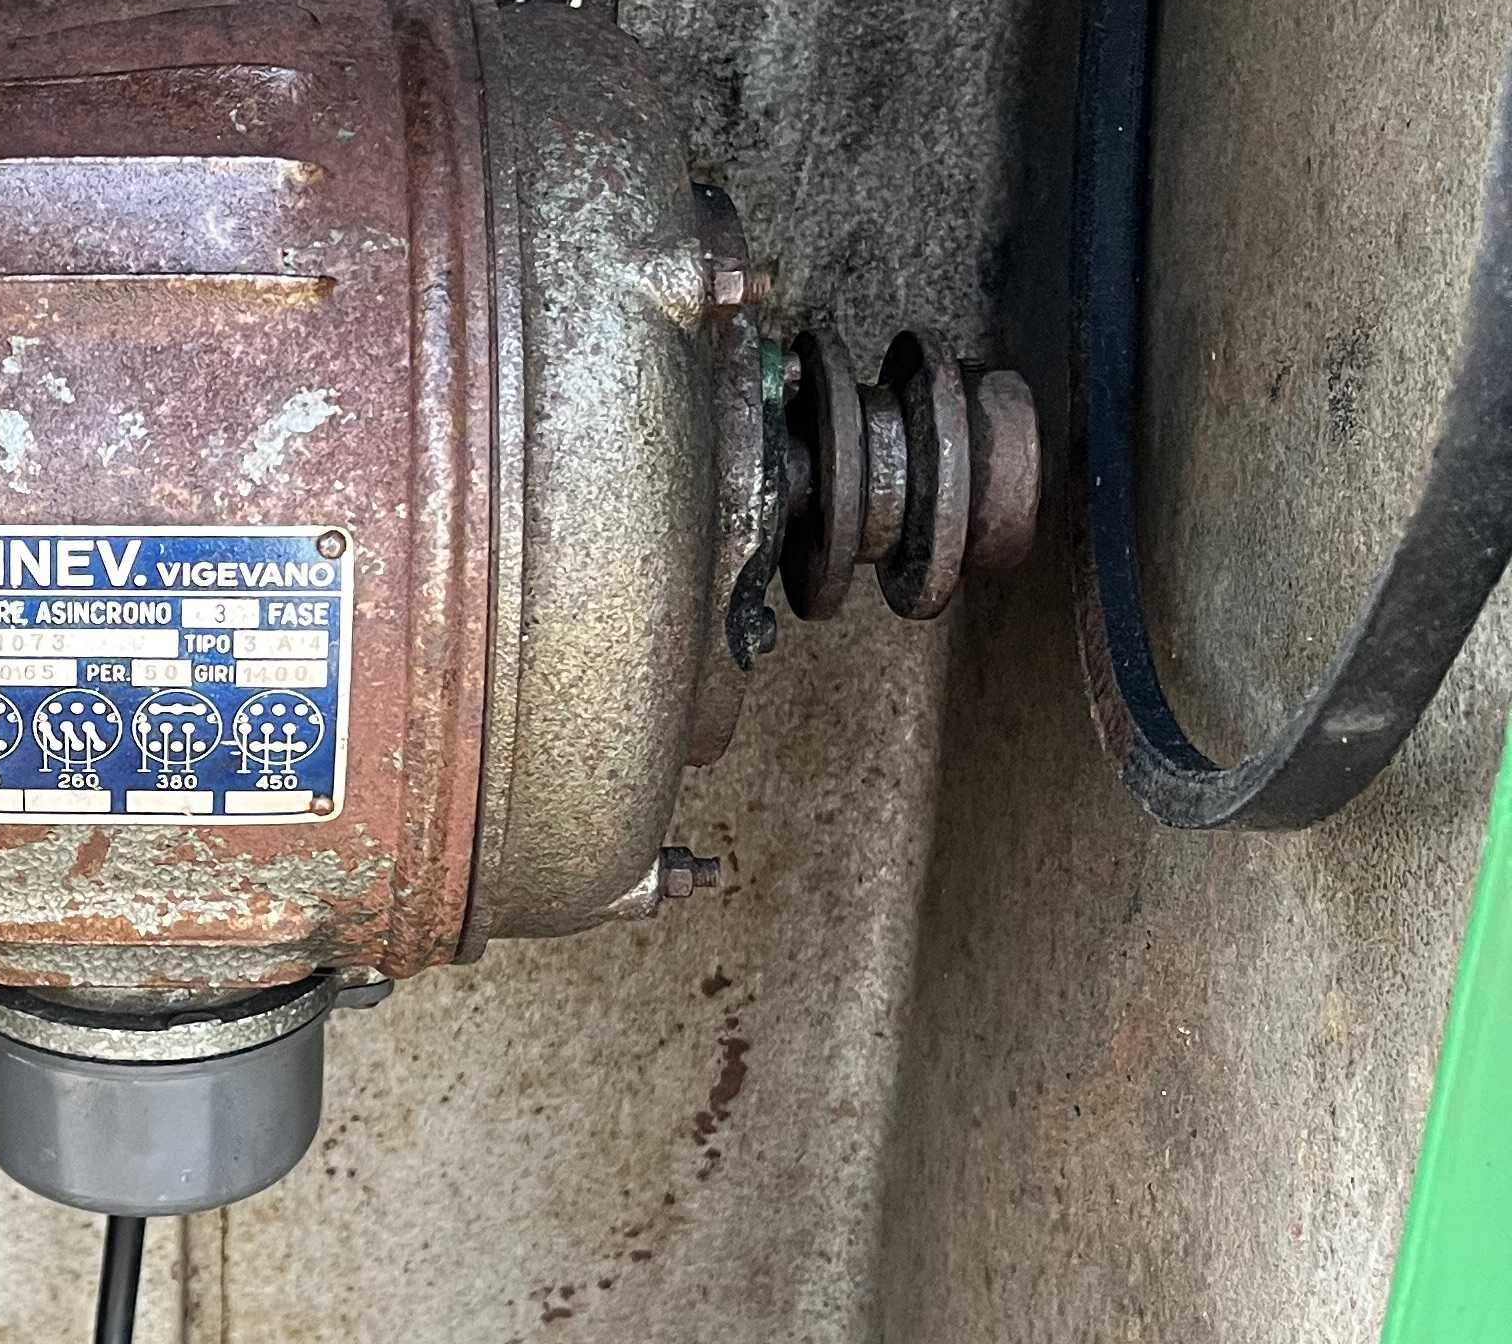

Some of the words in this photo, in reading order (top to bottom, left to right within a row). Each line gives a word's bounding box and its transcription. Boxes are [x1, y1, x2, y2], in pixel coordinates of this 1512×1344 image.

[157, 561, 335, 588] VIGEVANO
[35, 600, 172, 626] ASINCRONO
[214, 603, 226, 624] 3
[268, 602, 330, 626] FASE
[184, 634, 231, 654] TIPO
[87, 663, 131, 682] PER.
[194, 664, 234, 683] GIRI
[58, 773, 100, 789] 260
[156, 774, 198, 790] 380
[256, 774, 298, 790] 450
